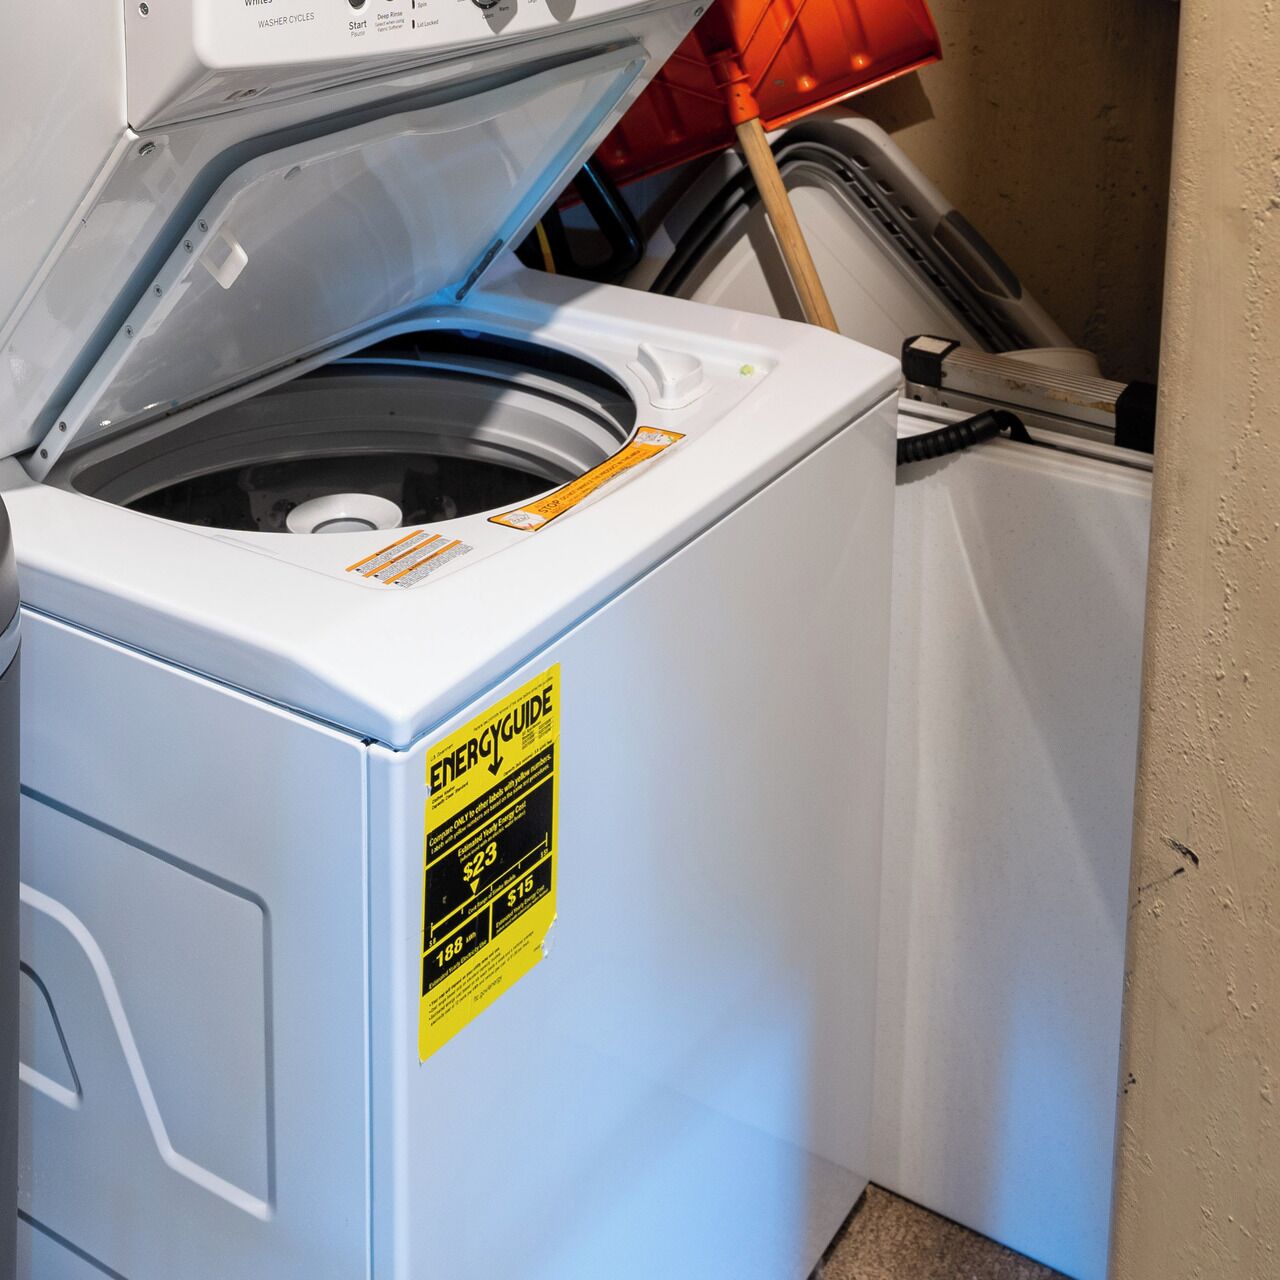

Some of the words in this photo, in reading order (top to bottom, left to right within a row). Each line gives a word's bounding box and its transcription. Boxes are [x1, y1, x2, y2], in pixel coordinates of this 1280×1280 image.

[257, 16, 288, 29] WASHER
[288, 12, 315, 24] CYCLES
[348, 20, 368, 31] Start
[377, 13, 390, 21] Deep
[390, 11, 403, 19] Rinse
[538, 499, 561, 514] STOP
[430, 686, 552, 794] ENERGYGUIDE
[430, 824, 452, 846] Compare
[454, 813, 467, 828] ONLY
[475, 799, 488, 812] other
[489, 787, 503, 802] labels
[504, 779, 514, 792] with
[515, 768, 529, 784] yellow
[531, 752, 551, 771] numbers.
[458, 833, 482, 855] Estimated
[483, 822, 497, 838] Yearly
[498, 809, 514, 827] Energy
[515, 799, 526, 813] Cost
[463, 841, 497, 884] $23
[507, 874, 533, 908] $15
[496, 910, 513, 927] Estimated
[514, 902, 523, 914] Yearly
[524, 892, 535, 906] Energy
[429, 970, 448, 989] Estimated
[449, 959, 460, 973] Yearly
[461, 944, 478, 963] Electricity
[436, 935, 463, 969] 188
